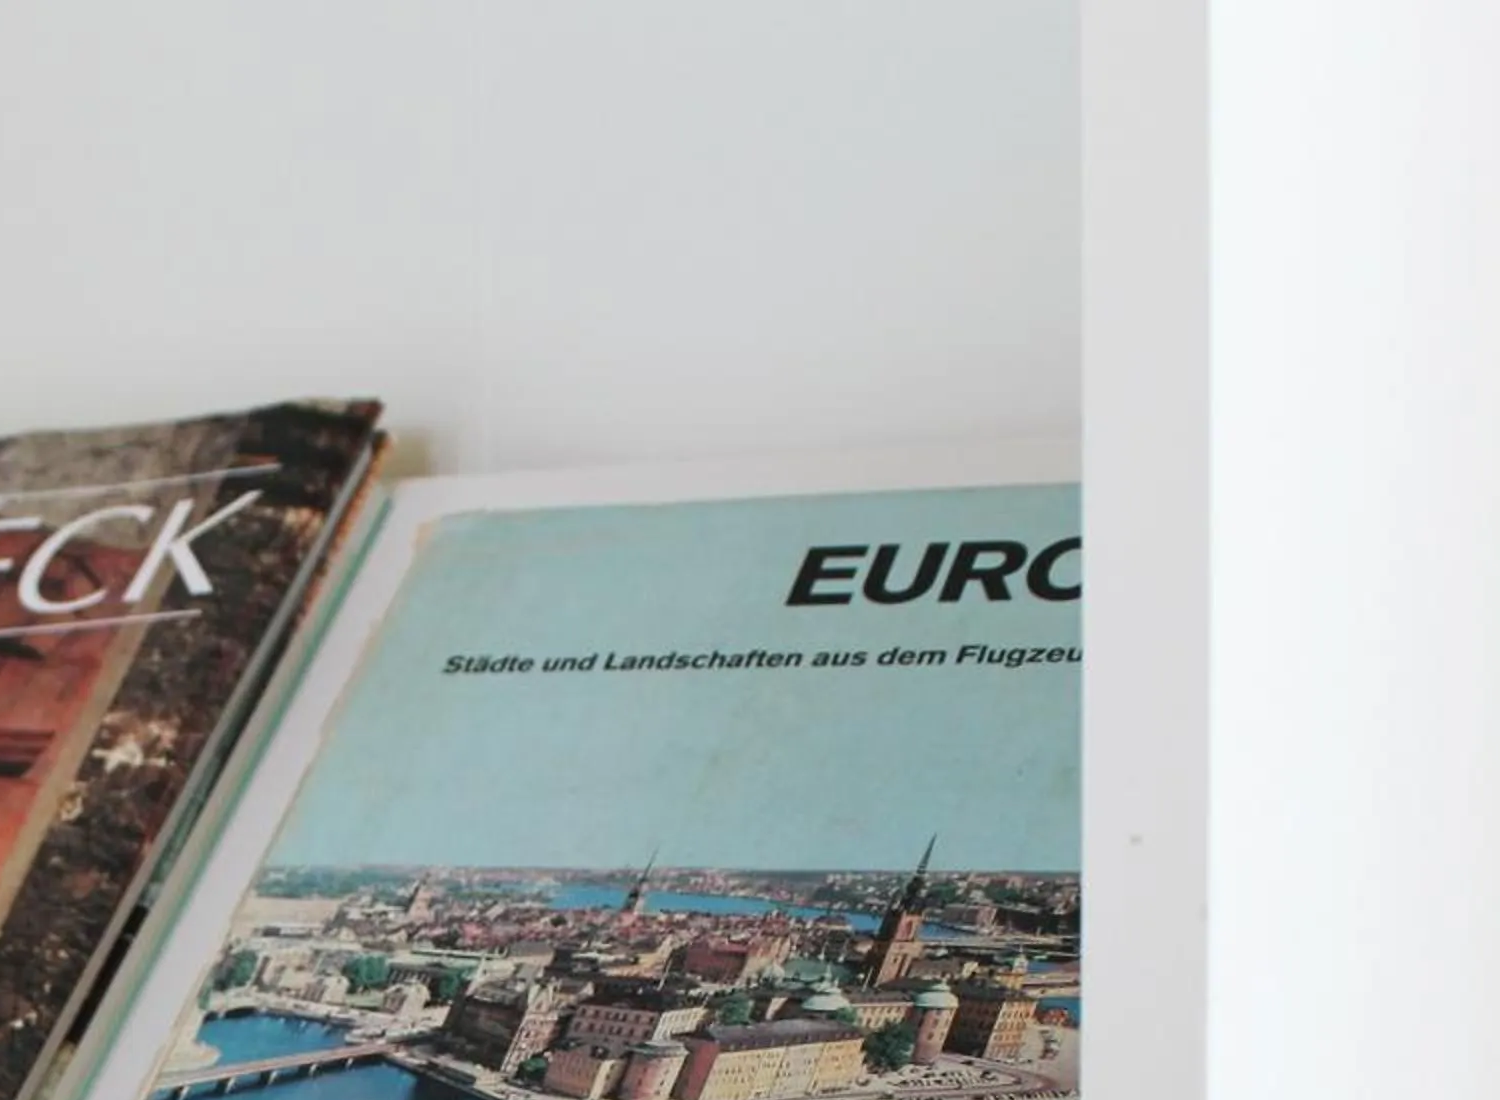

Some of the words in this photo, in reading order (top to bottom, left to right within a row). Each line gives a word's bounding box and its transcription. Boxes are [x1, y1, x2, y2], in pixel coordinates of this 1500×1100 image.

[442, 653, 534, 675] Städte
[542, 652, 597, 673] und
[603, 647, 803, 672] Landschaften
[811, 649, 867, 669] aus
[876, 645, 946, 668] dem
